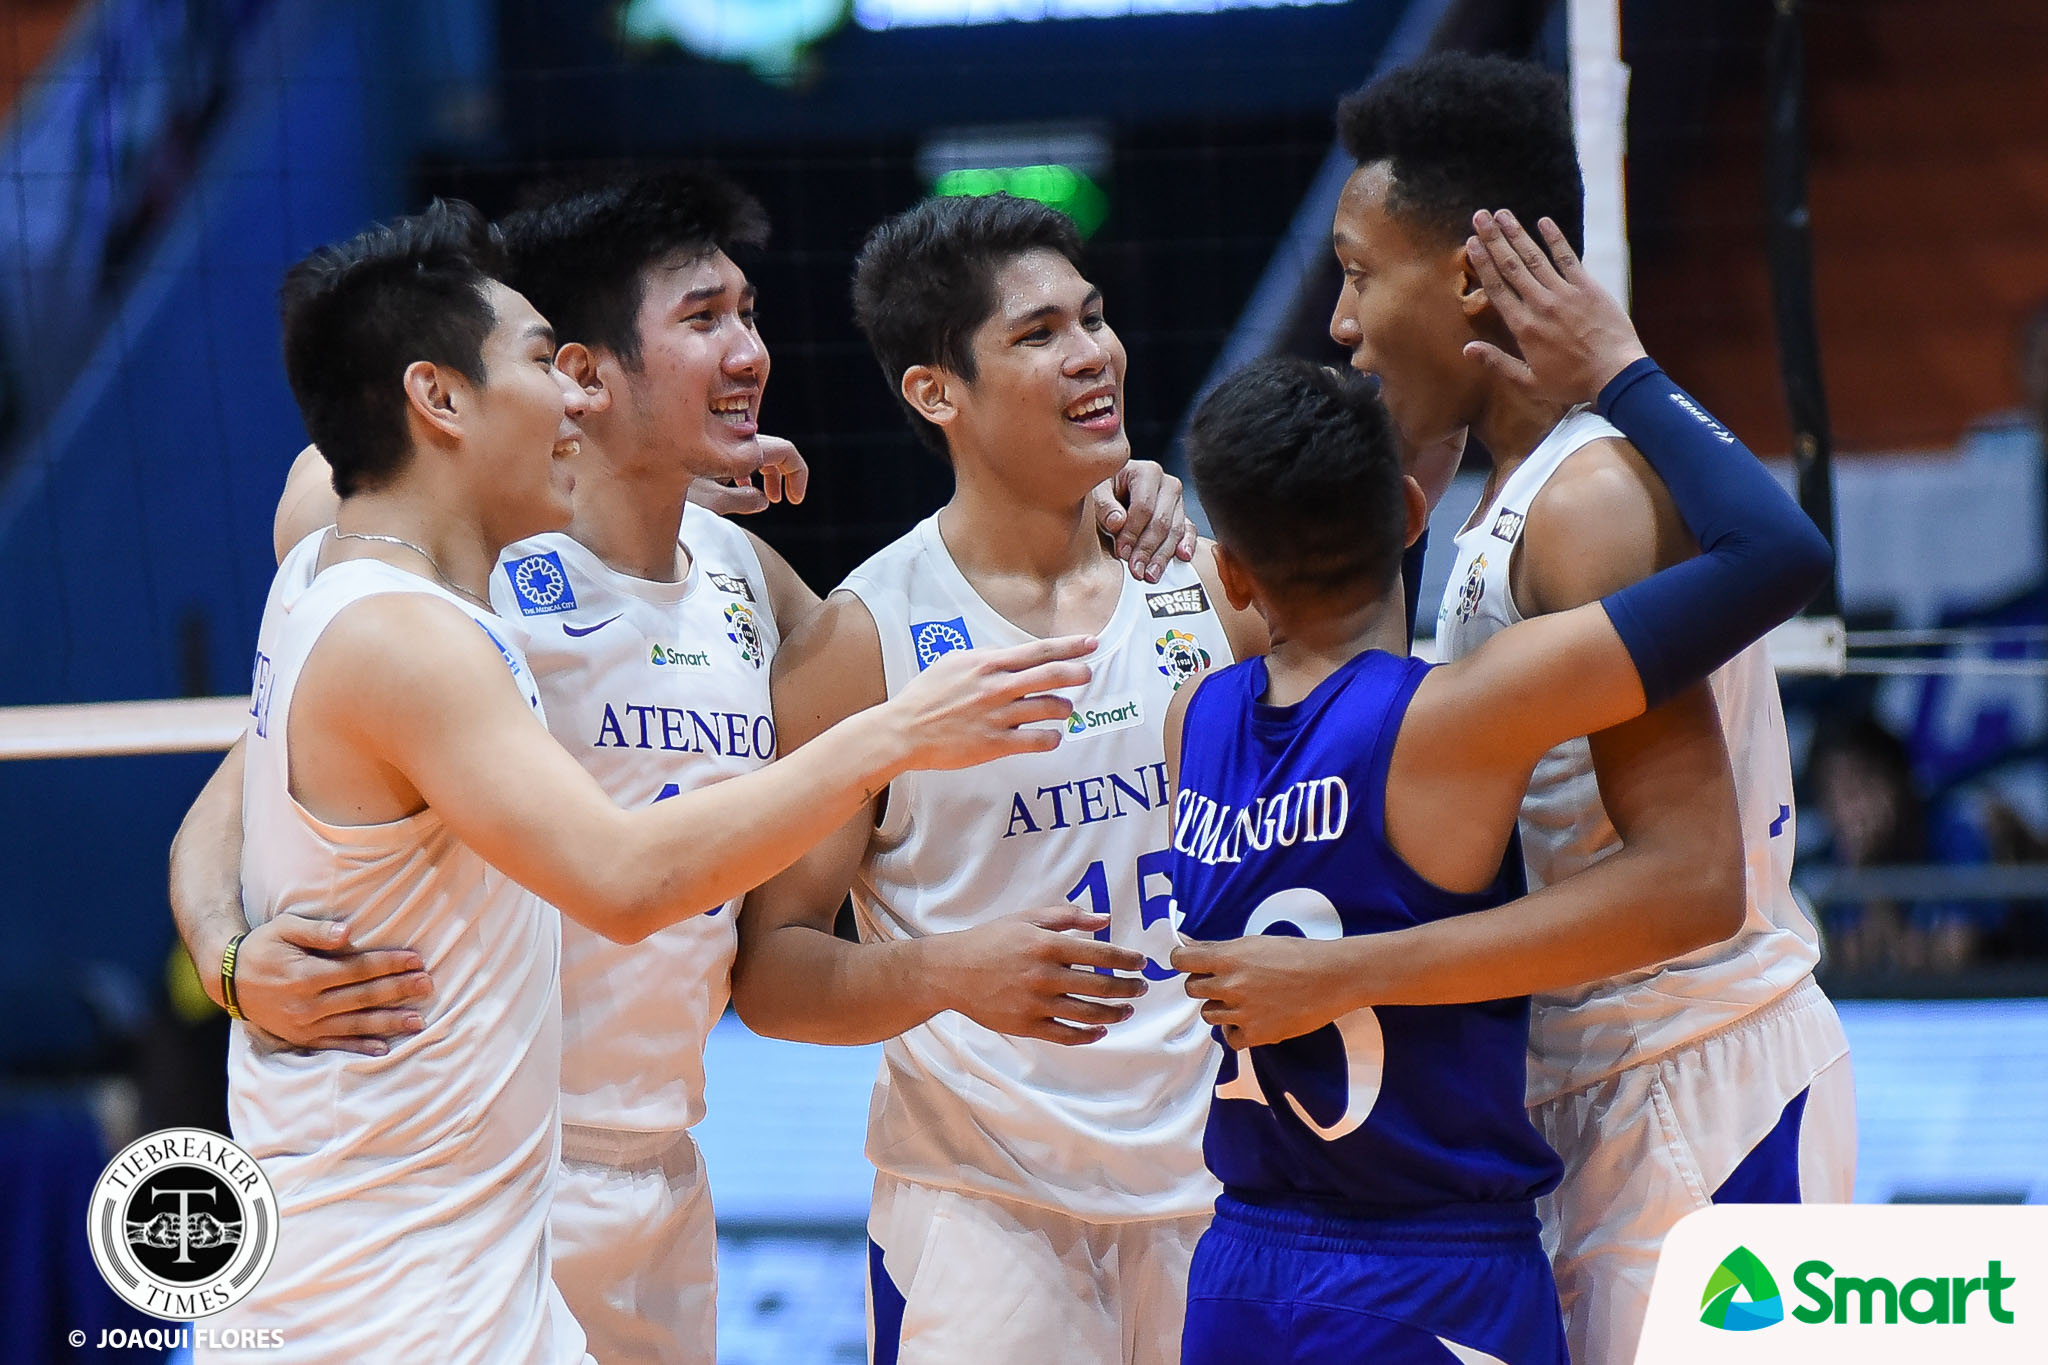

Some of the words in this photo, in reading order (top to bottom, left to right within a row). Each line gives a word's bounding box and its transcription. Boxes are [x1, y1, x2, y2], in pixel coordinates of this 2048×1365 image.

[536, 603, 562, 613] MEDICAL
[561, 601, 575, 609] CITY
[1148, 589, 1201, 612] FUDGEE
[1165, 601, 1203, 615] BARR
[666, 647, 711, 667] Smart
[1085, 701, 1139, 728] Smart
[594, 702, 776, 760] ATENEO
[1002, 761, 1170, 839] ATENE
[222, 943, 237, 978] FAITH
